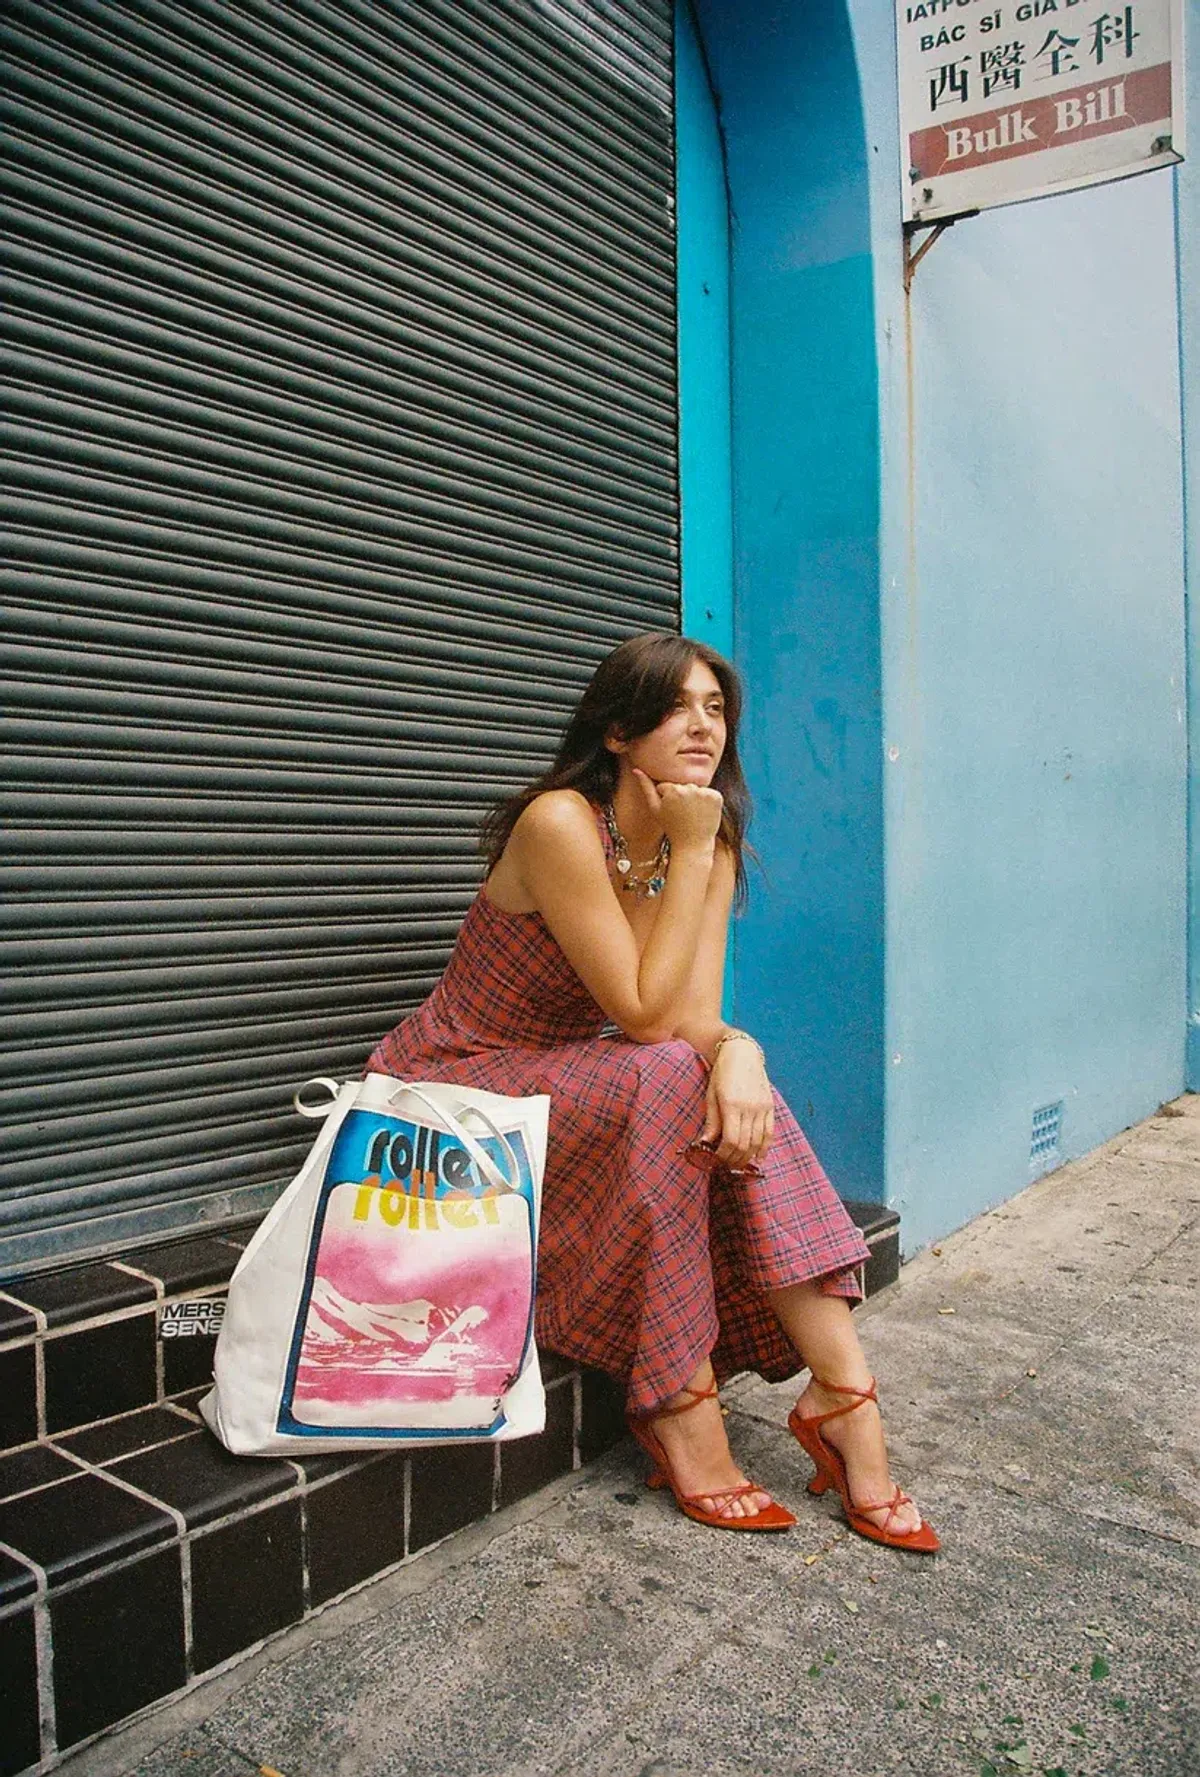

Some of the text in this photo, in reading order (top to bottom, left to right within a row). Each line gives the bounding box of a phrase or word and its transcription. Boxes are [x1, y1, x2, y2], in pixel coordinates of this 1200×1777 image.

[920, 25, 966, 51] BÁC
[1016, 0, 1058, 22] GIA
[926, 6, 1140, 112] 西醫全科
[946, 81, 1127, 161] Bulk Bill
[353, 1169, 501, 1231] roller
